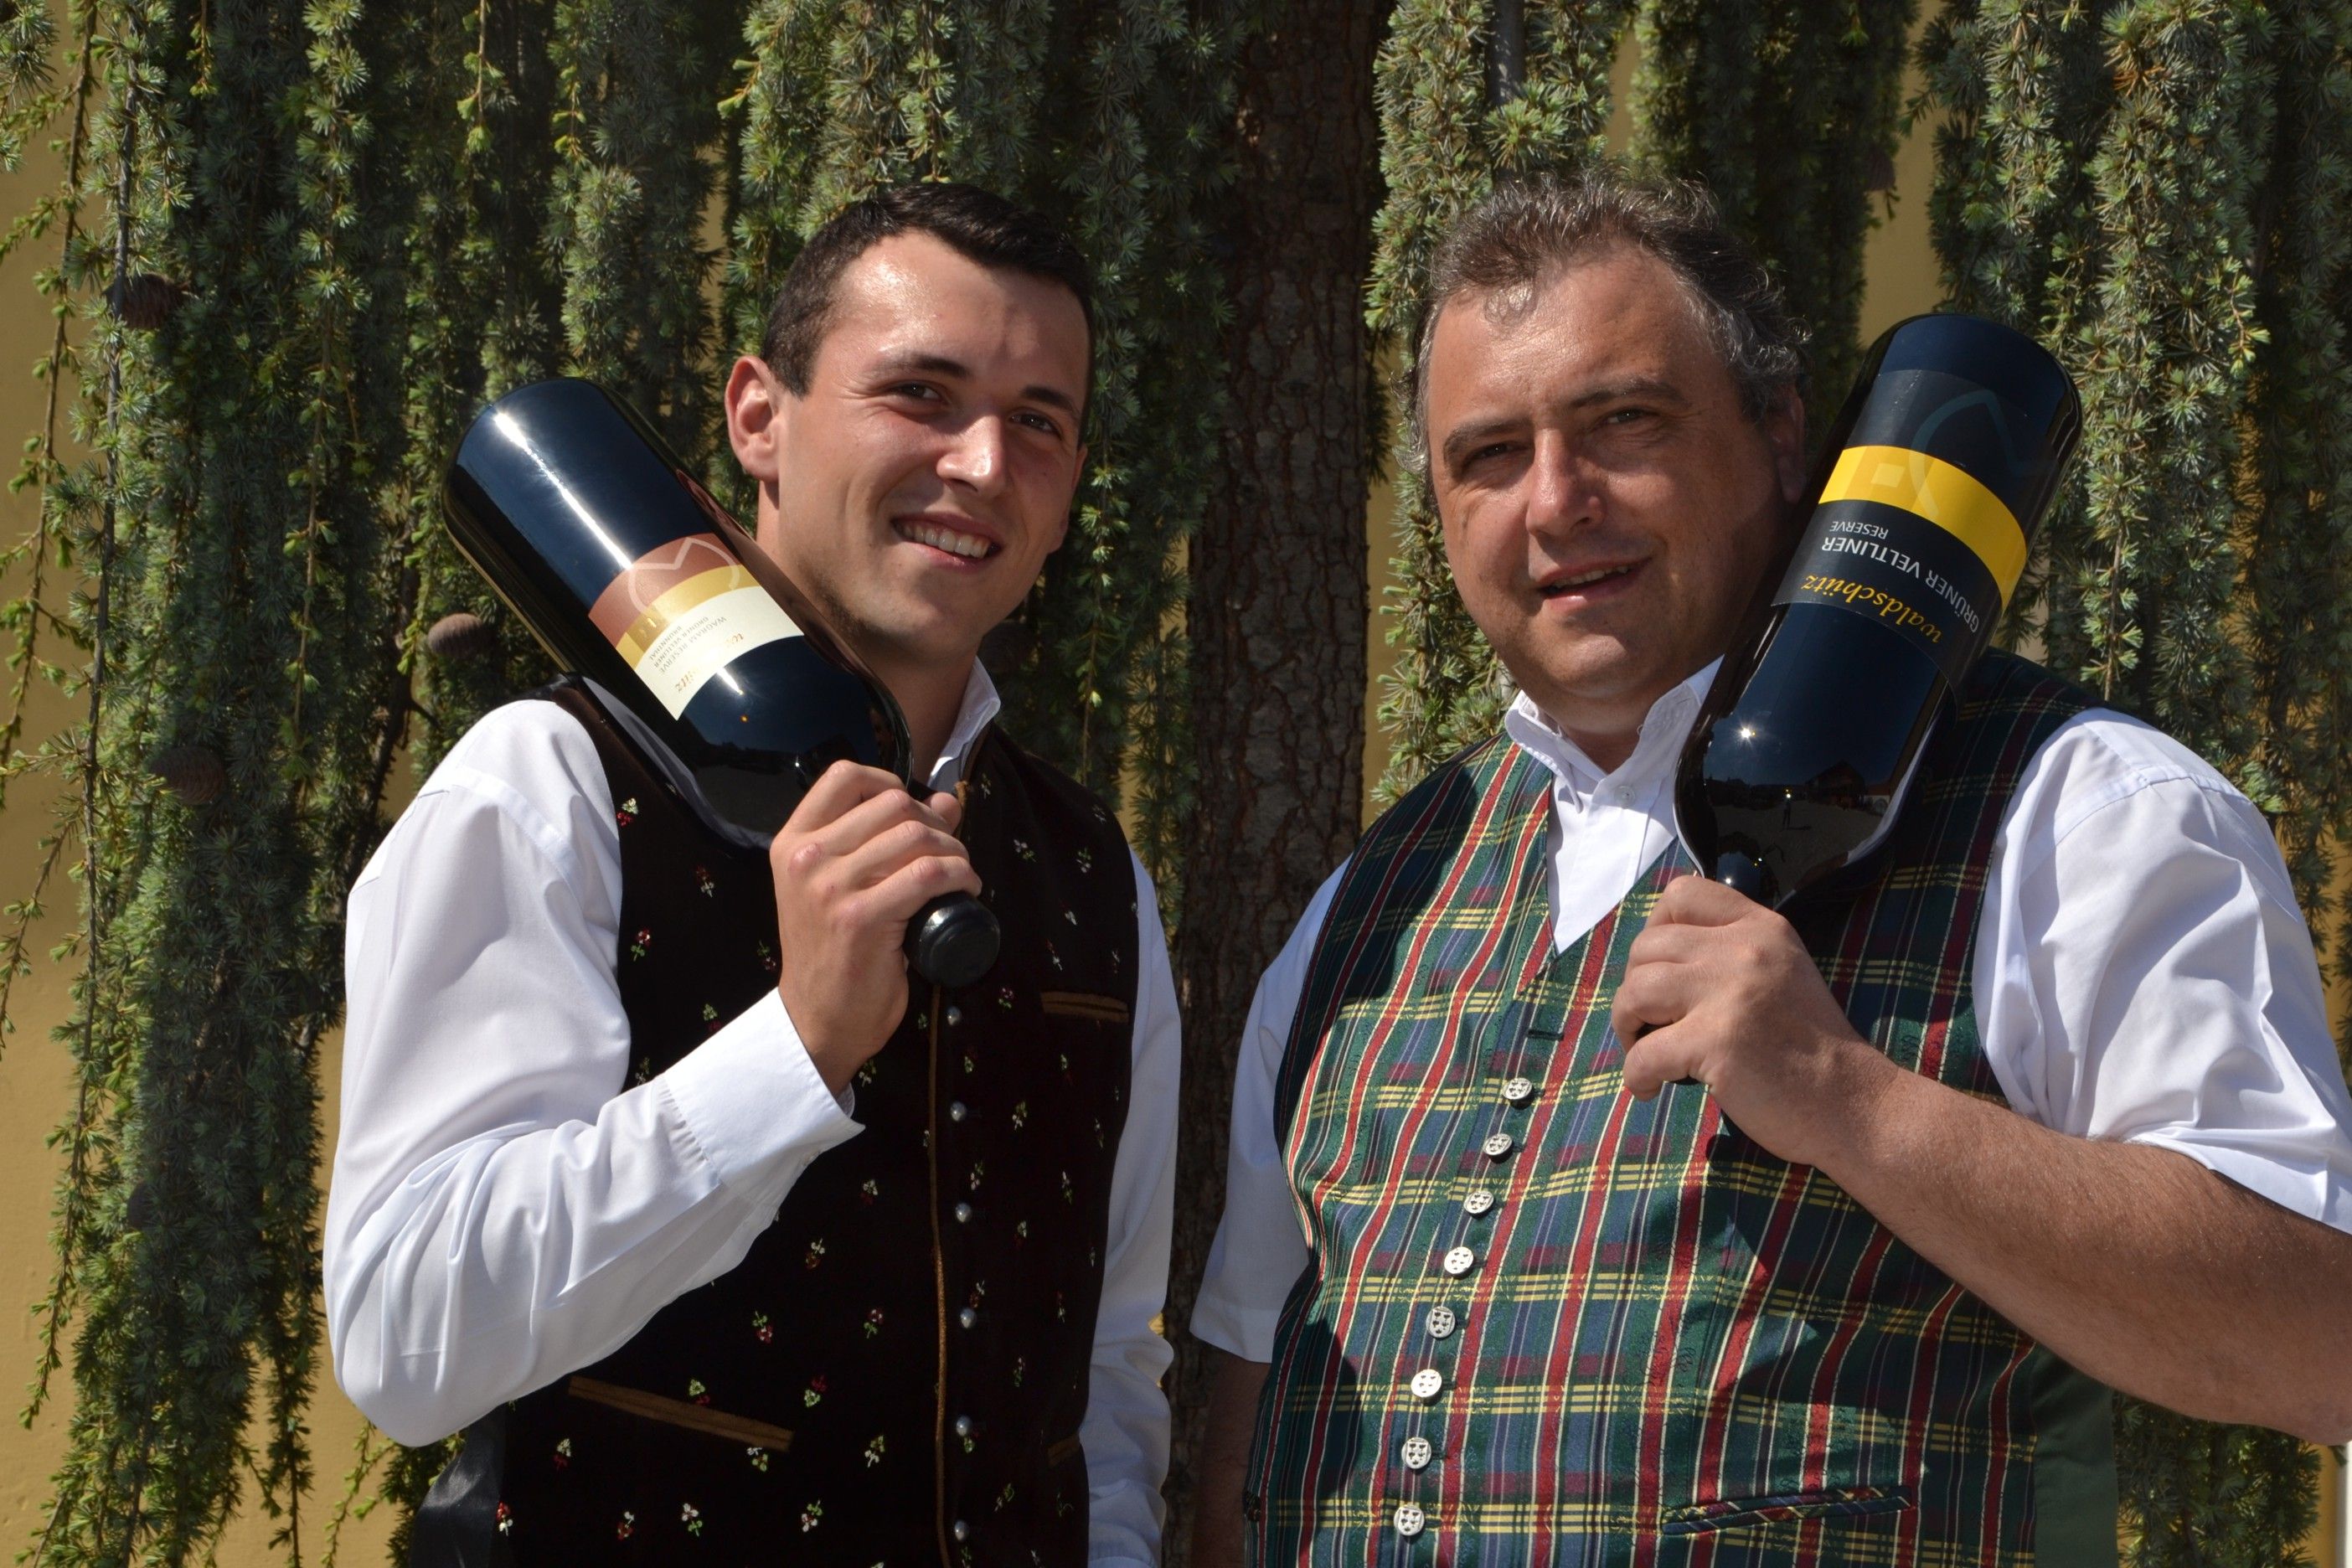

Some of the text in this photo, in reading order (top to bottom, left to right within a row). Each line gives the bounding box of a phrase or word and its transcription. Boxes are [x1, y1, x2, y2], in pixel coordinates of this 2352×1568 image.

[1829, 521, 1889, 539] RESERVE
[1802, 575, 1942, 643] waldschütz
[1822, 537, 1979, 633] GRÜNER VELTLINER
